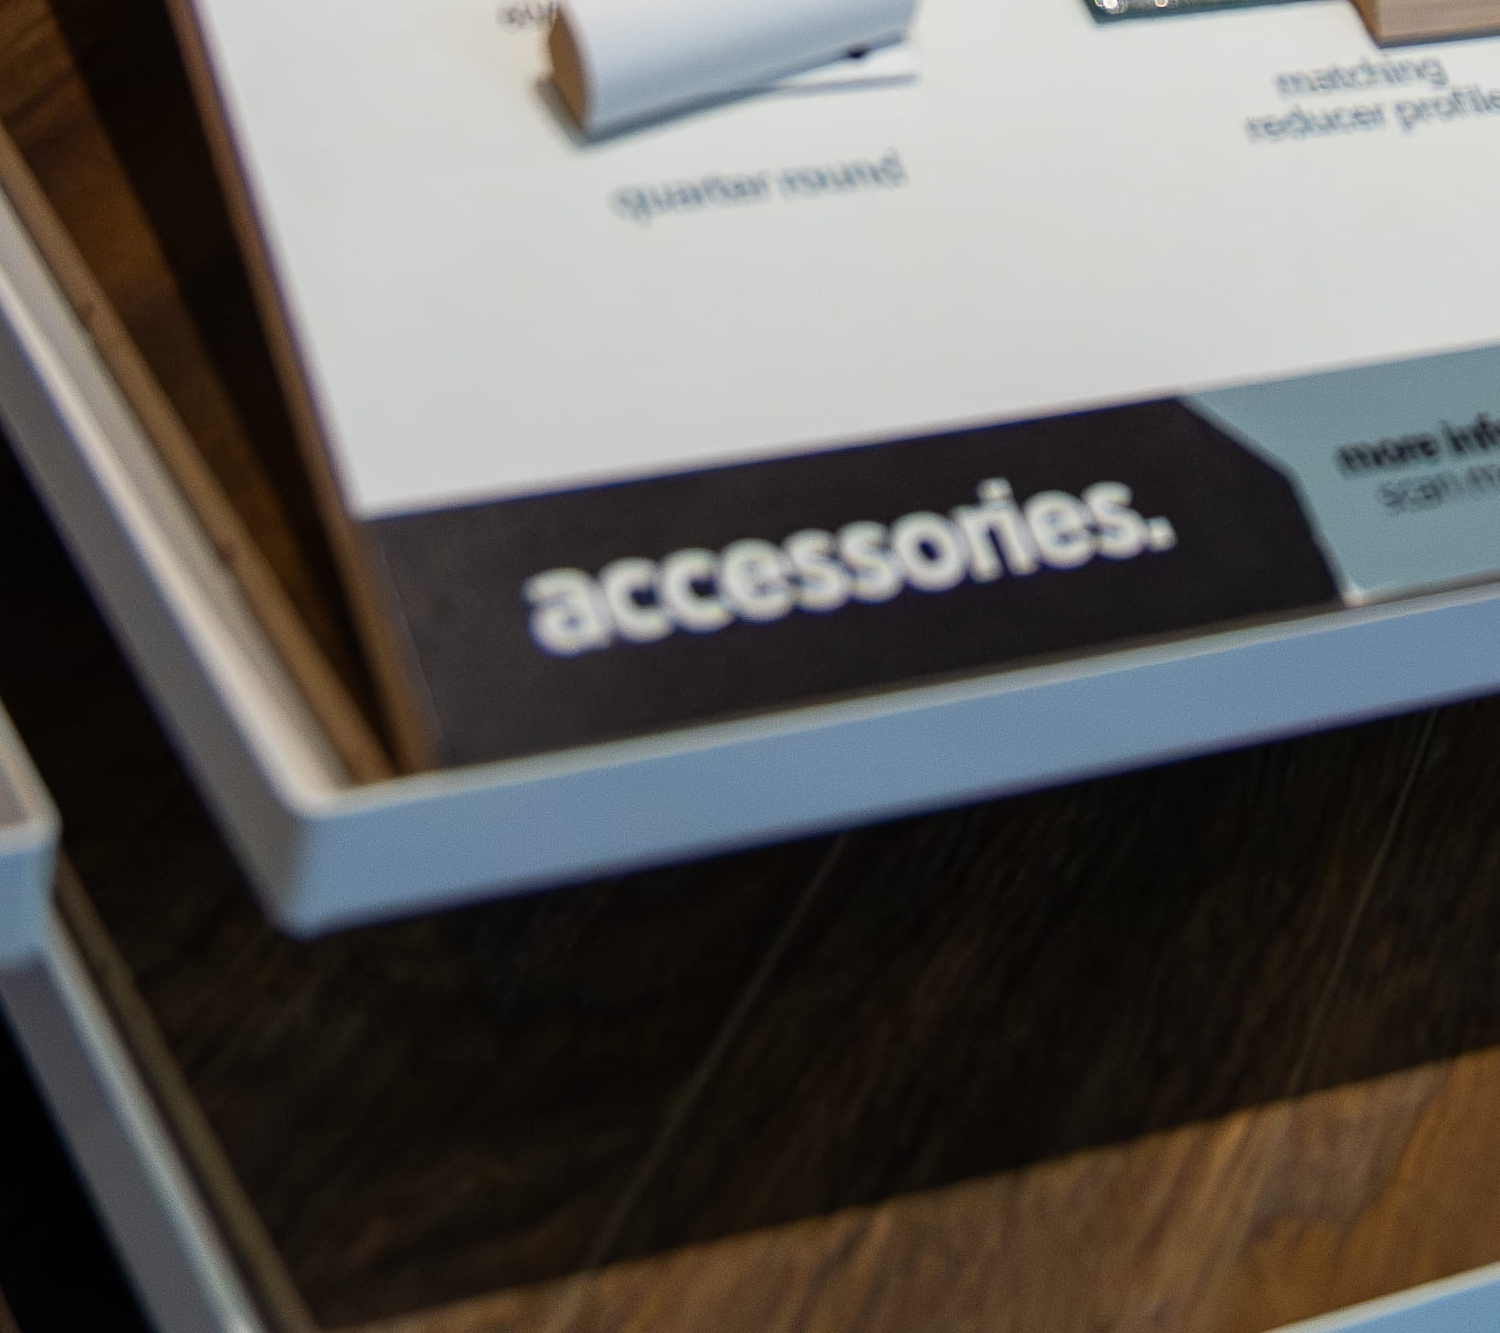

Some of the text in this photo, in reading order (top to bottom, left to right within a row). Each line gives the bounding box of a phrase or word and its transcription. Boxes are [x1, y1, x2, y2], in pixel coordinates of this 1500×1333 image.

[1274, 56, 1450, 97] matching
[1335, 434, 1441, 475] more
[522, 479, 1178, 654] accessories.
